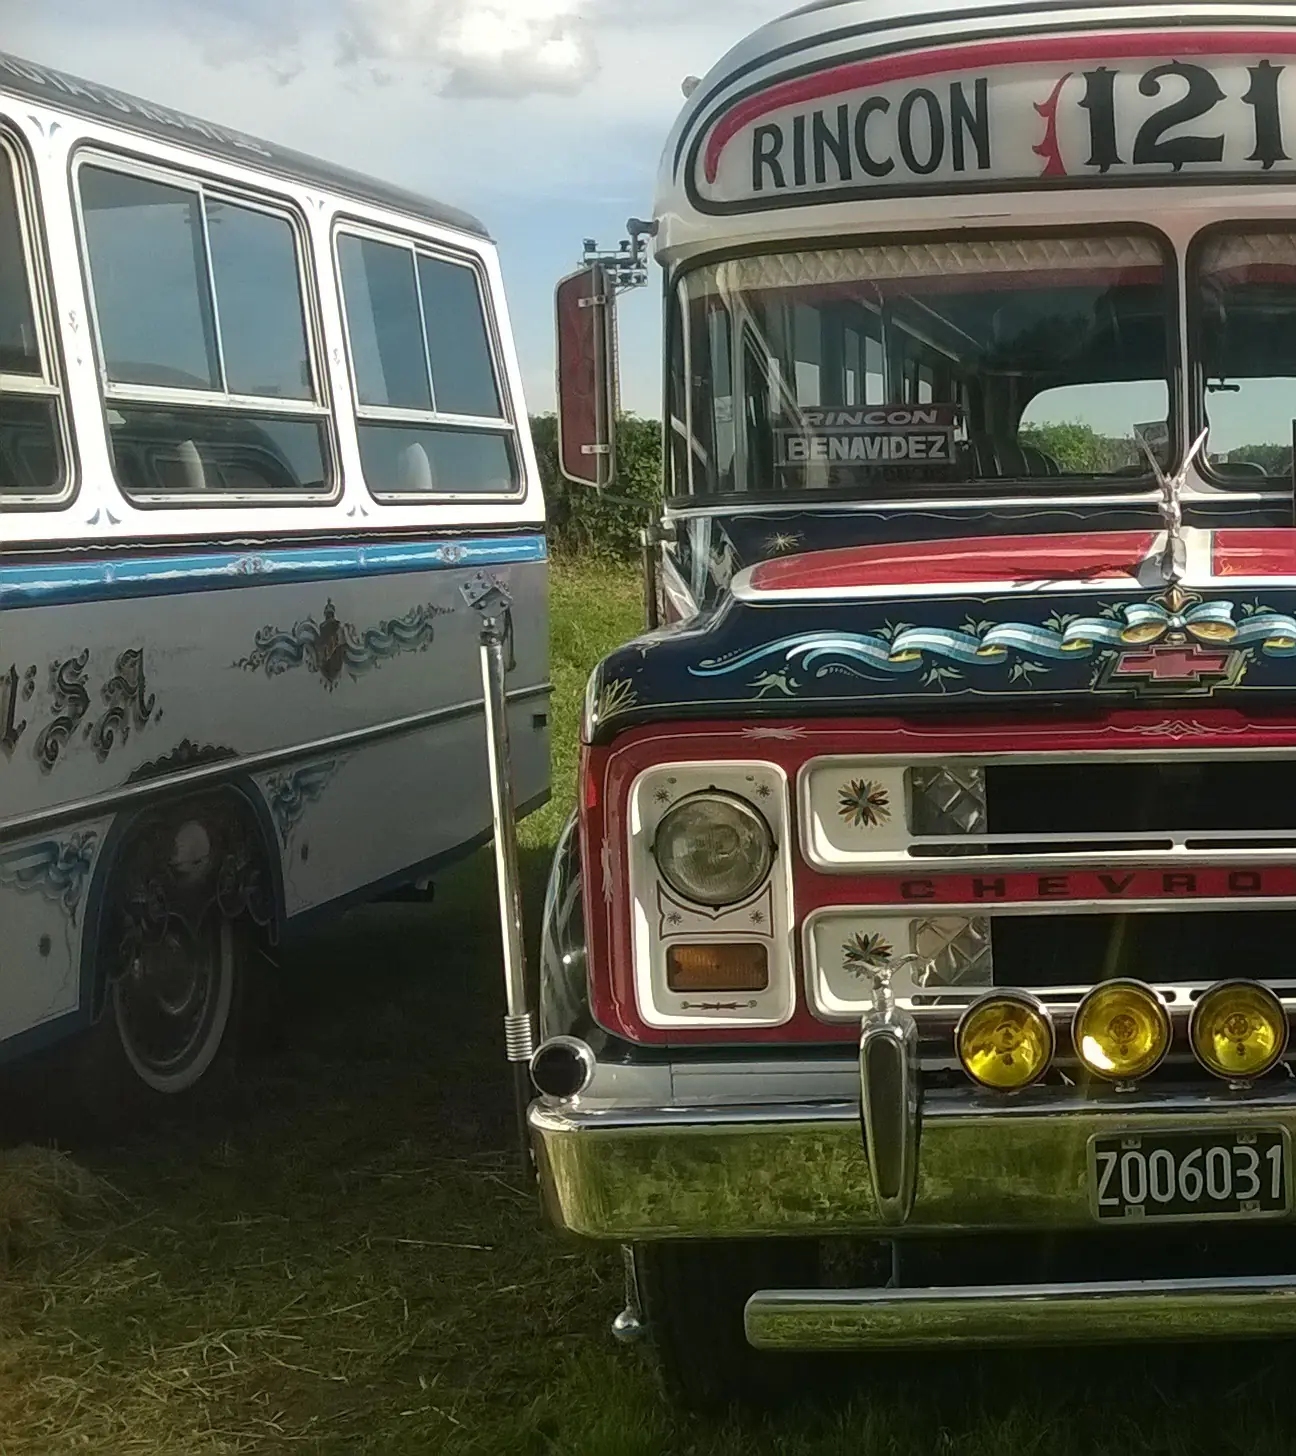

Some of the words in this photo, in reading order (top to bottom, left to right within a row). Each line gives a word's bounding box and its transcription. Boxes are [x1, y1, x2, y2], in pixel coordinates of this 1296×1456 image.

[751, 77, 991, 191] RINCON
[1078, 58, 1287, 174] 121
[801, 409, 938, 426] RINCON
[787, 435, 946, 461] BENAVIDEZ
[1096, 1144, 1282, 1206] Z006031
